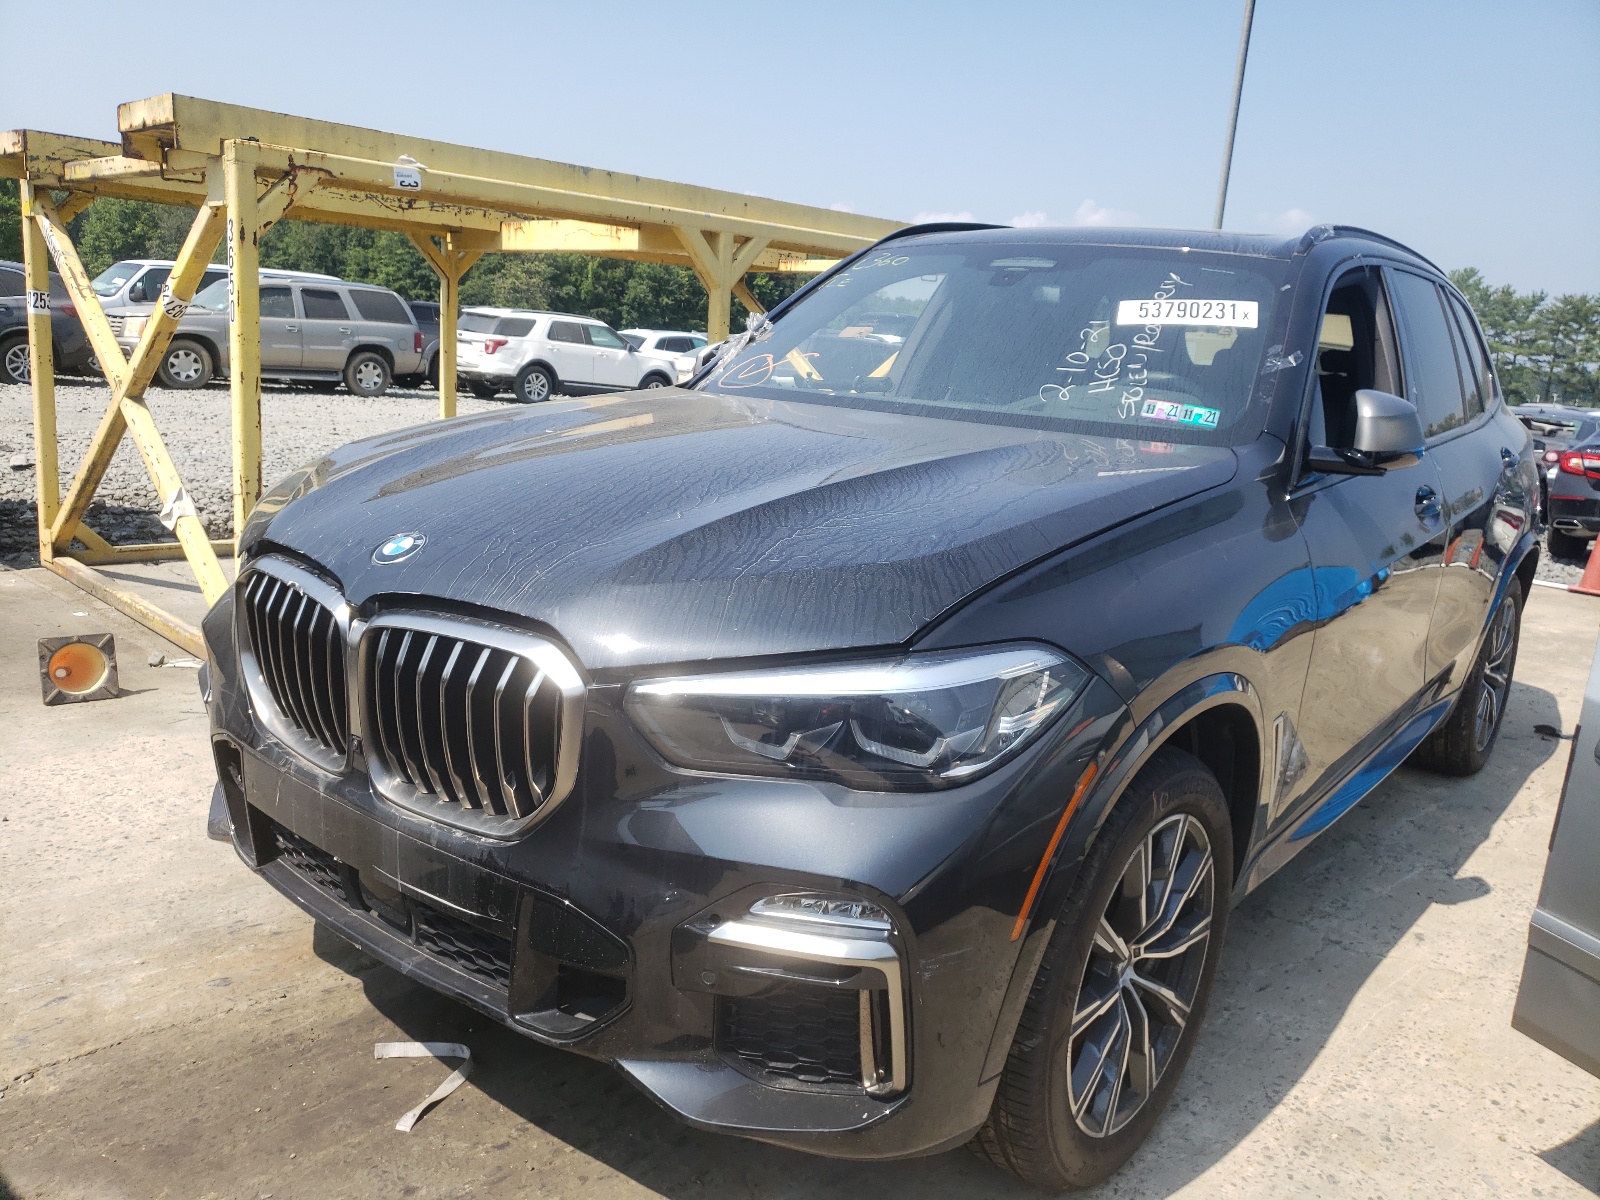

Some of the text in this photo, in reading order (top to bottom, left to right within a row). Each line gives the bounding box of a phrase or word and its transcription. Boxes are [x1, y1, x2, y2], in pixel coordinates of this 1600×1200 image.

[1138, 301, 1236, 320] 53790231
[1146, 404, 1179, 418] 11 21
[1183, 408, 1216, 424] 11 21
